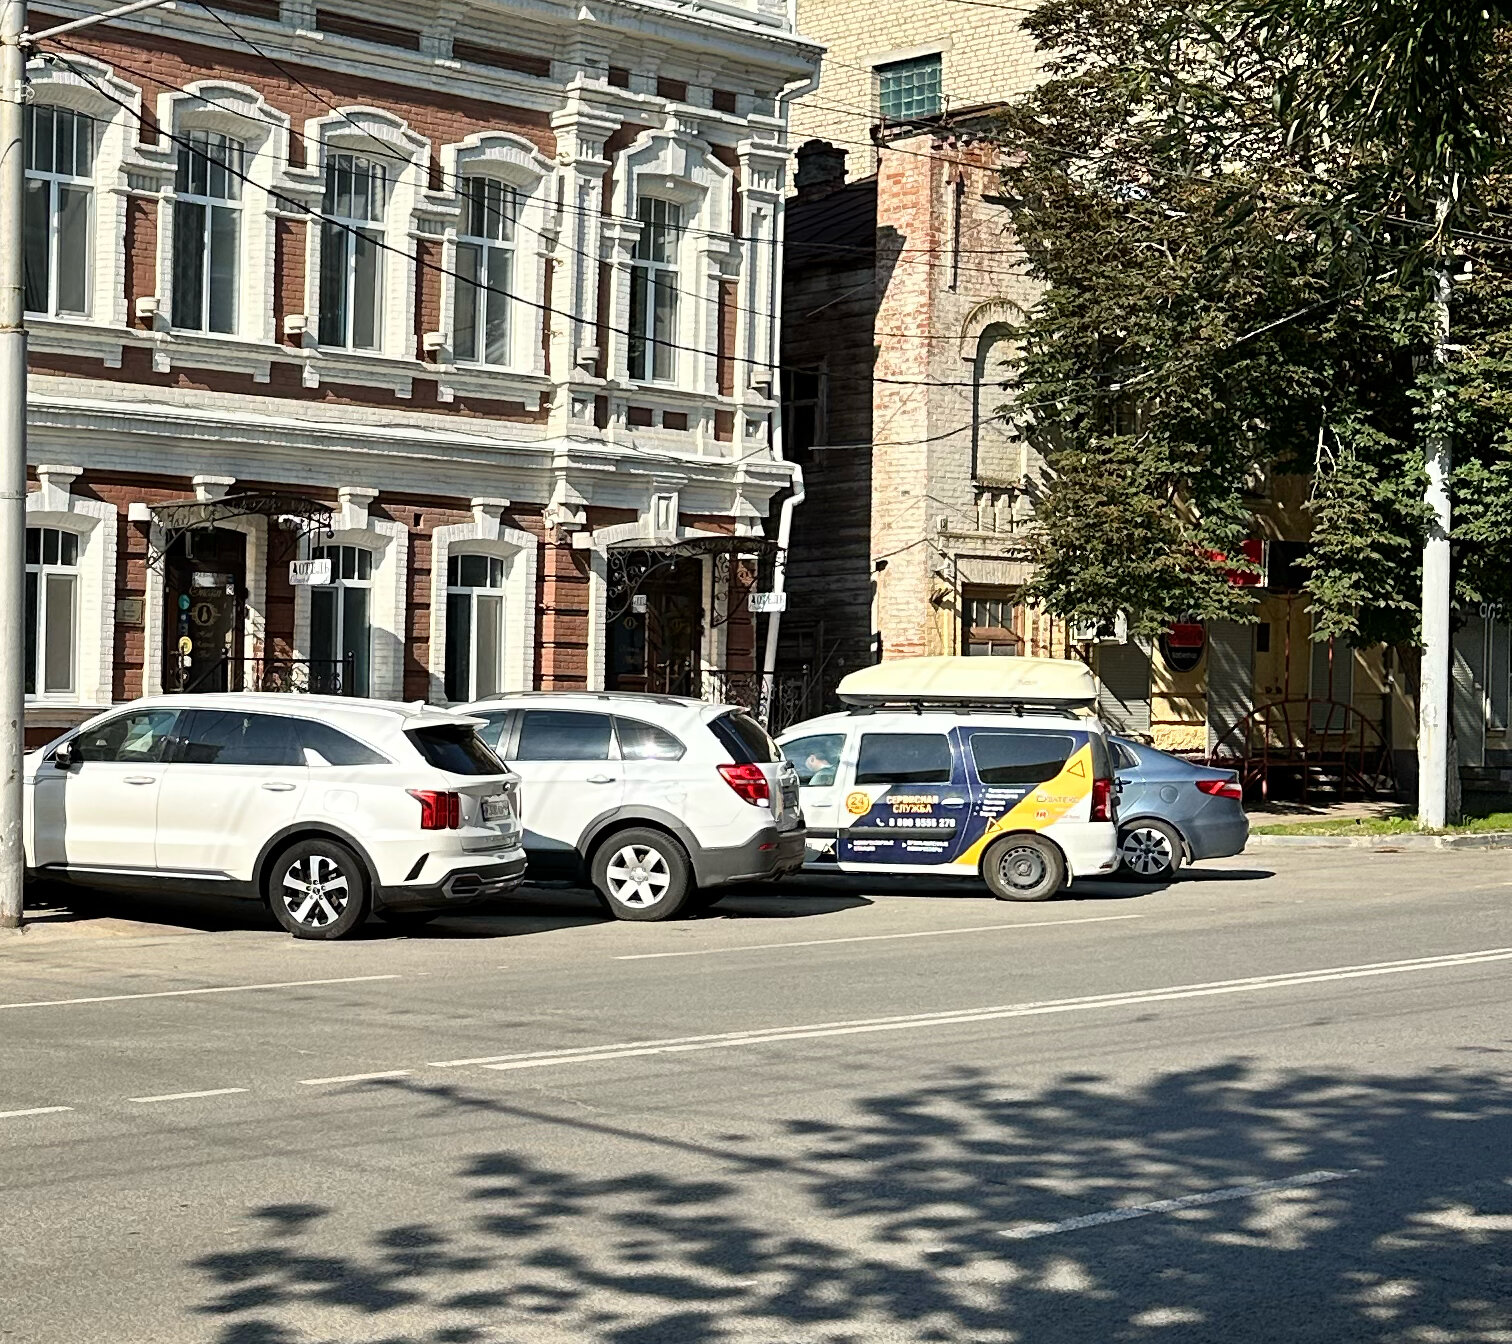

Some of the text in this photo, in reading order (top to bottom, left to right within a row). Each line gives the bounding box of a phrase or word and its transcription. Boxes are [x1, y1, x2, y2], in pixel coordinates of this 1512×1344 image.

[851, 796, 865, 805] 24
[886, 795, 939, 805] СЕРВИСНАЯ
[892, 804, 932, 814] СЛУЖБА
